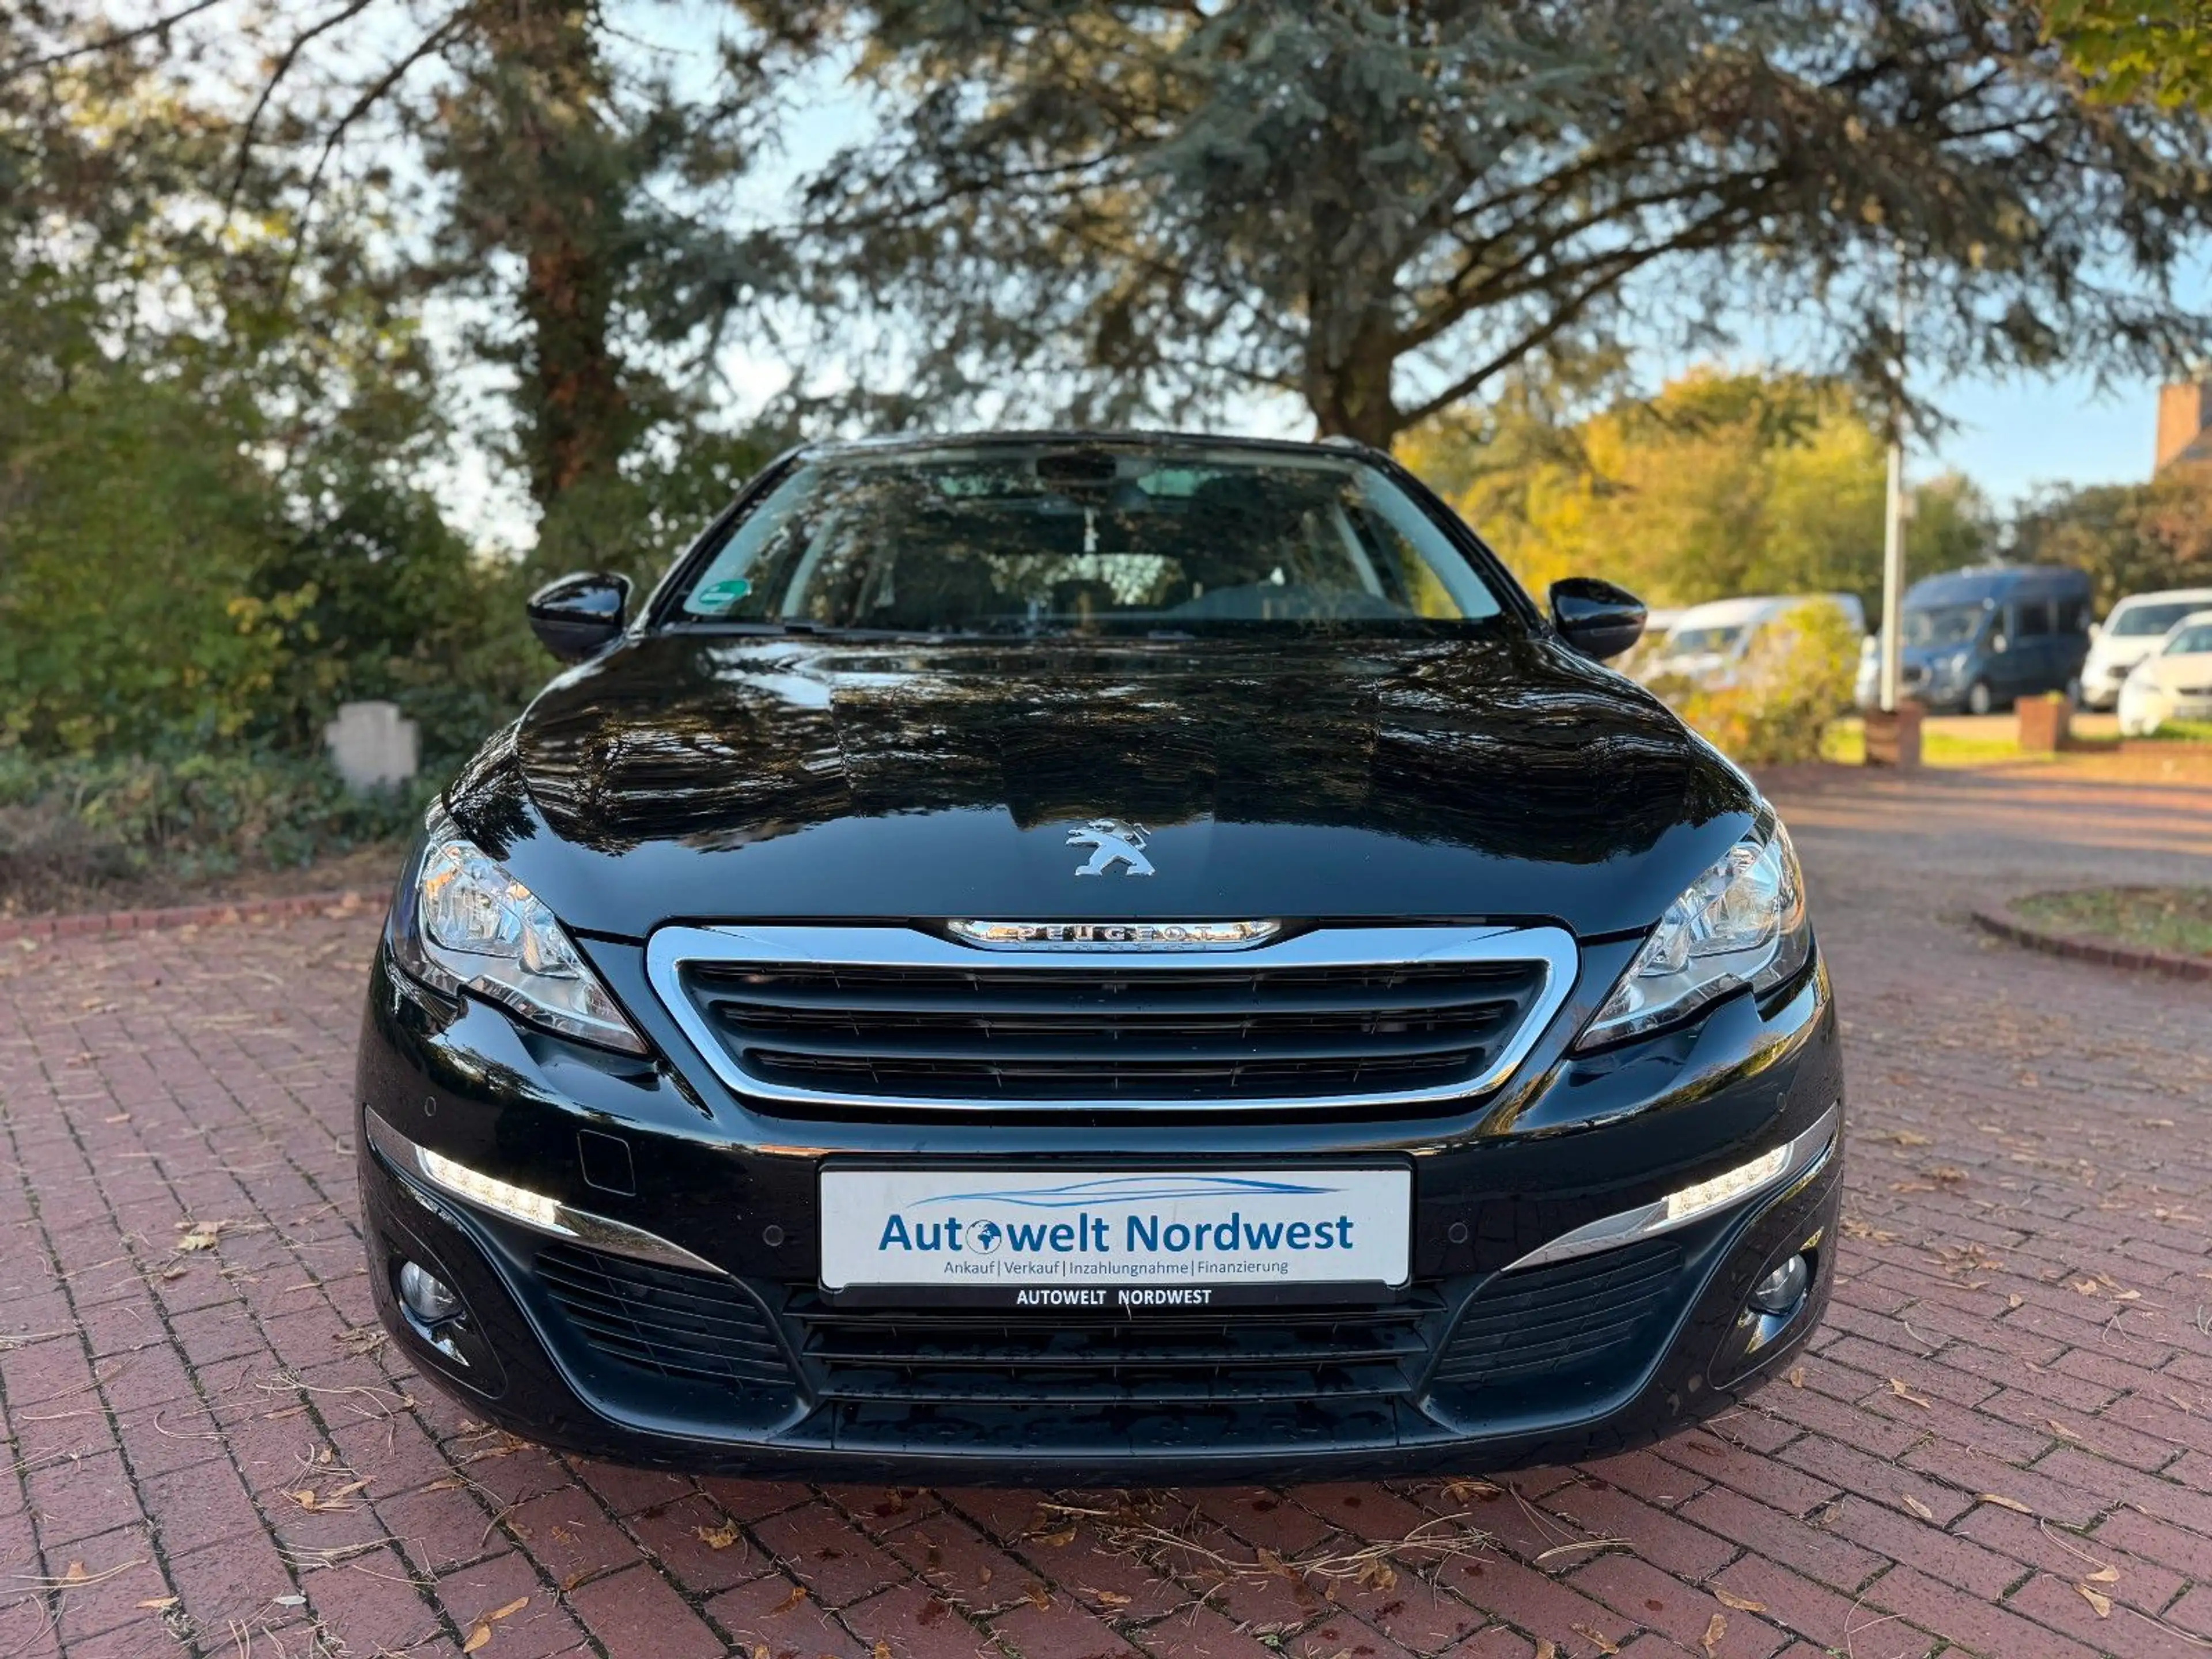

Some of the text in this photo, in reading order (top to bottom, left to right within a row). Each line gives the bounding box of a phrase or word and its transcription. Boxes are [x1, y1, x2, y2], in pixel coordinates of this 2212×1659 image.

[1017, 925, 1212, 941] PEUGEOT
[878, 1212, 1354, 1255] Autowelt Nordwest
[944, 1260, 1289, 1277] Ankauf Verkauf Inzahlungnahme Finanzierung
[1017, 1289, 1212, 1304] AUTOWELT NORDWEST
